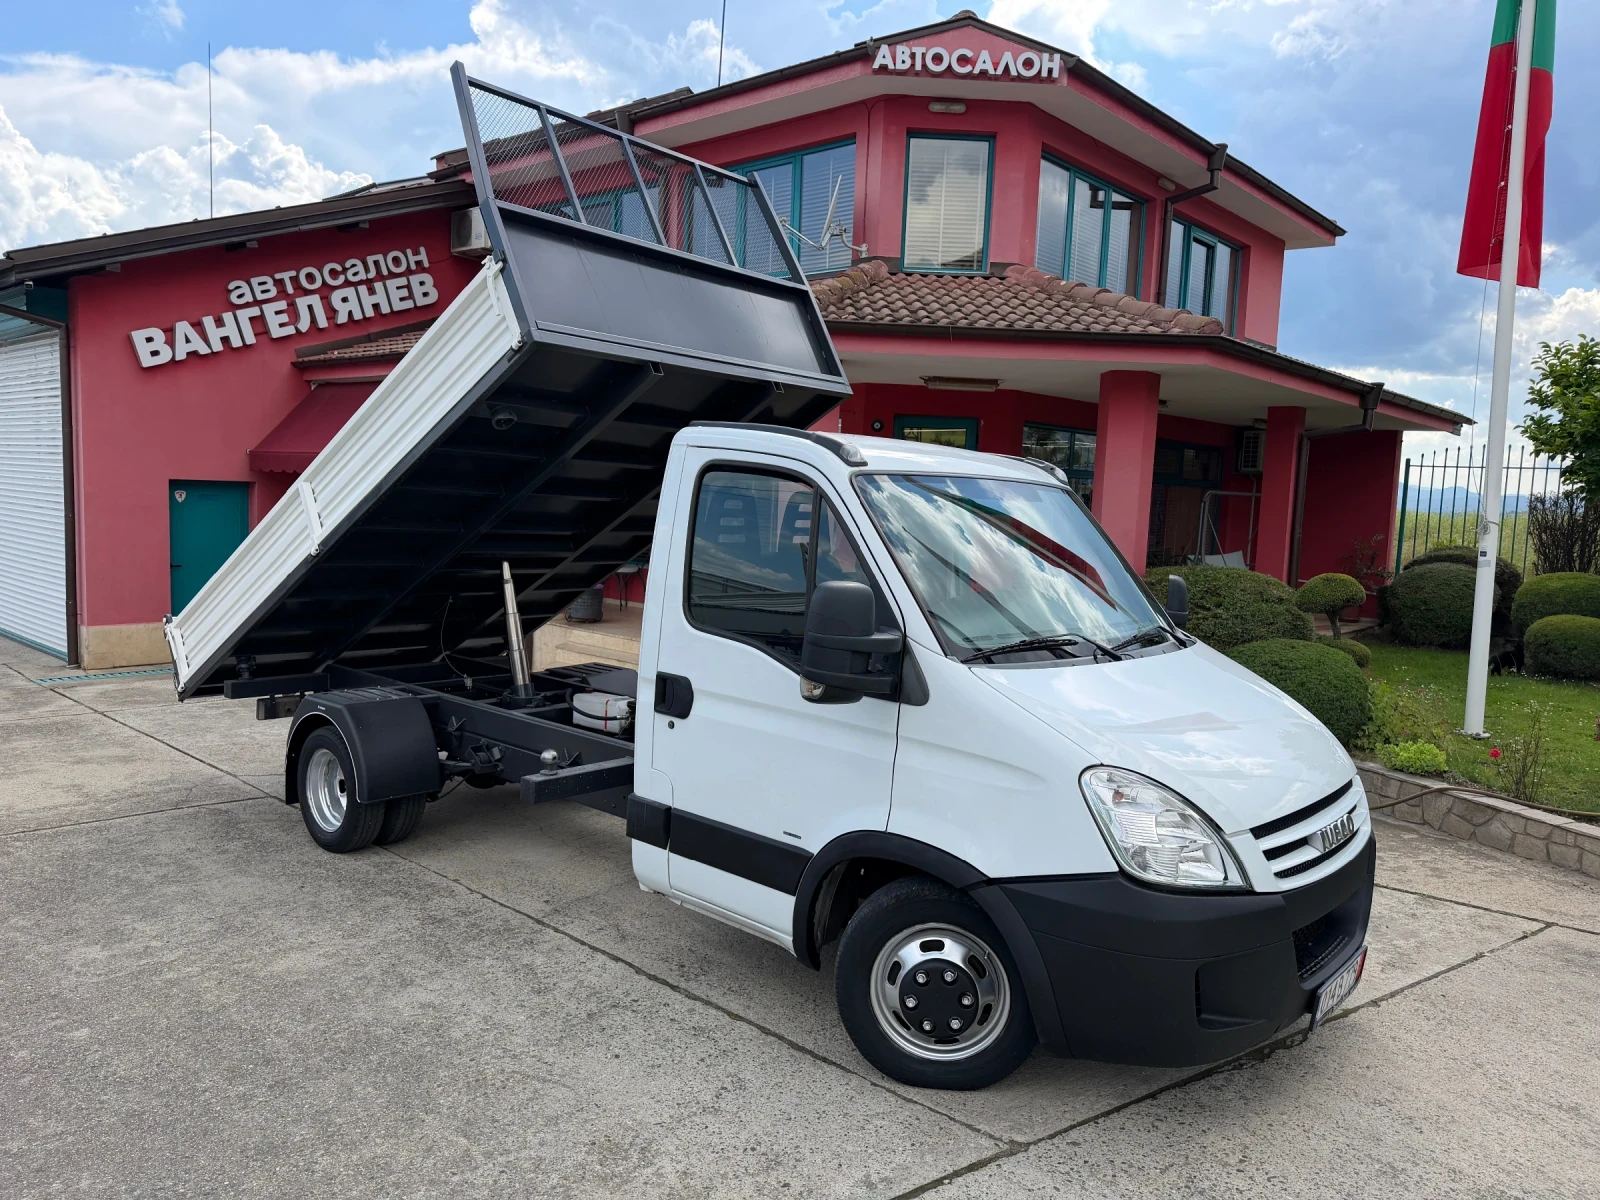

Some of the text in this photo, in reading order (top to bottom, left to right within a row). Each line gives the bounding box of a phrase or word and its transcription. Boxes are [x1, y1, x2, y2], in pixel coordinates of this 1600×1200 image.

[873, 44, 1061, 78] АВТОСАЛОН
[228, 246, 429, 304] автосалон
[130, 273, 438, 368] ВАНГЕЛ ЯНЕВ
[1316, 814, 1355, 851] IVECO
